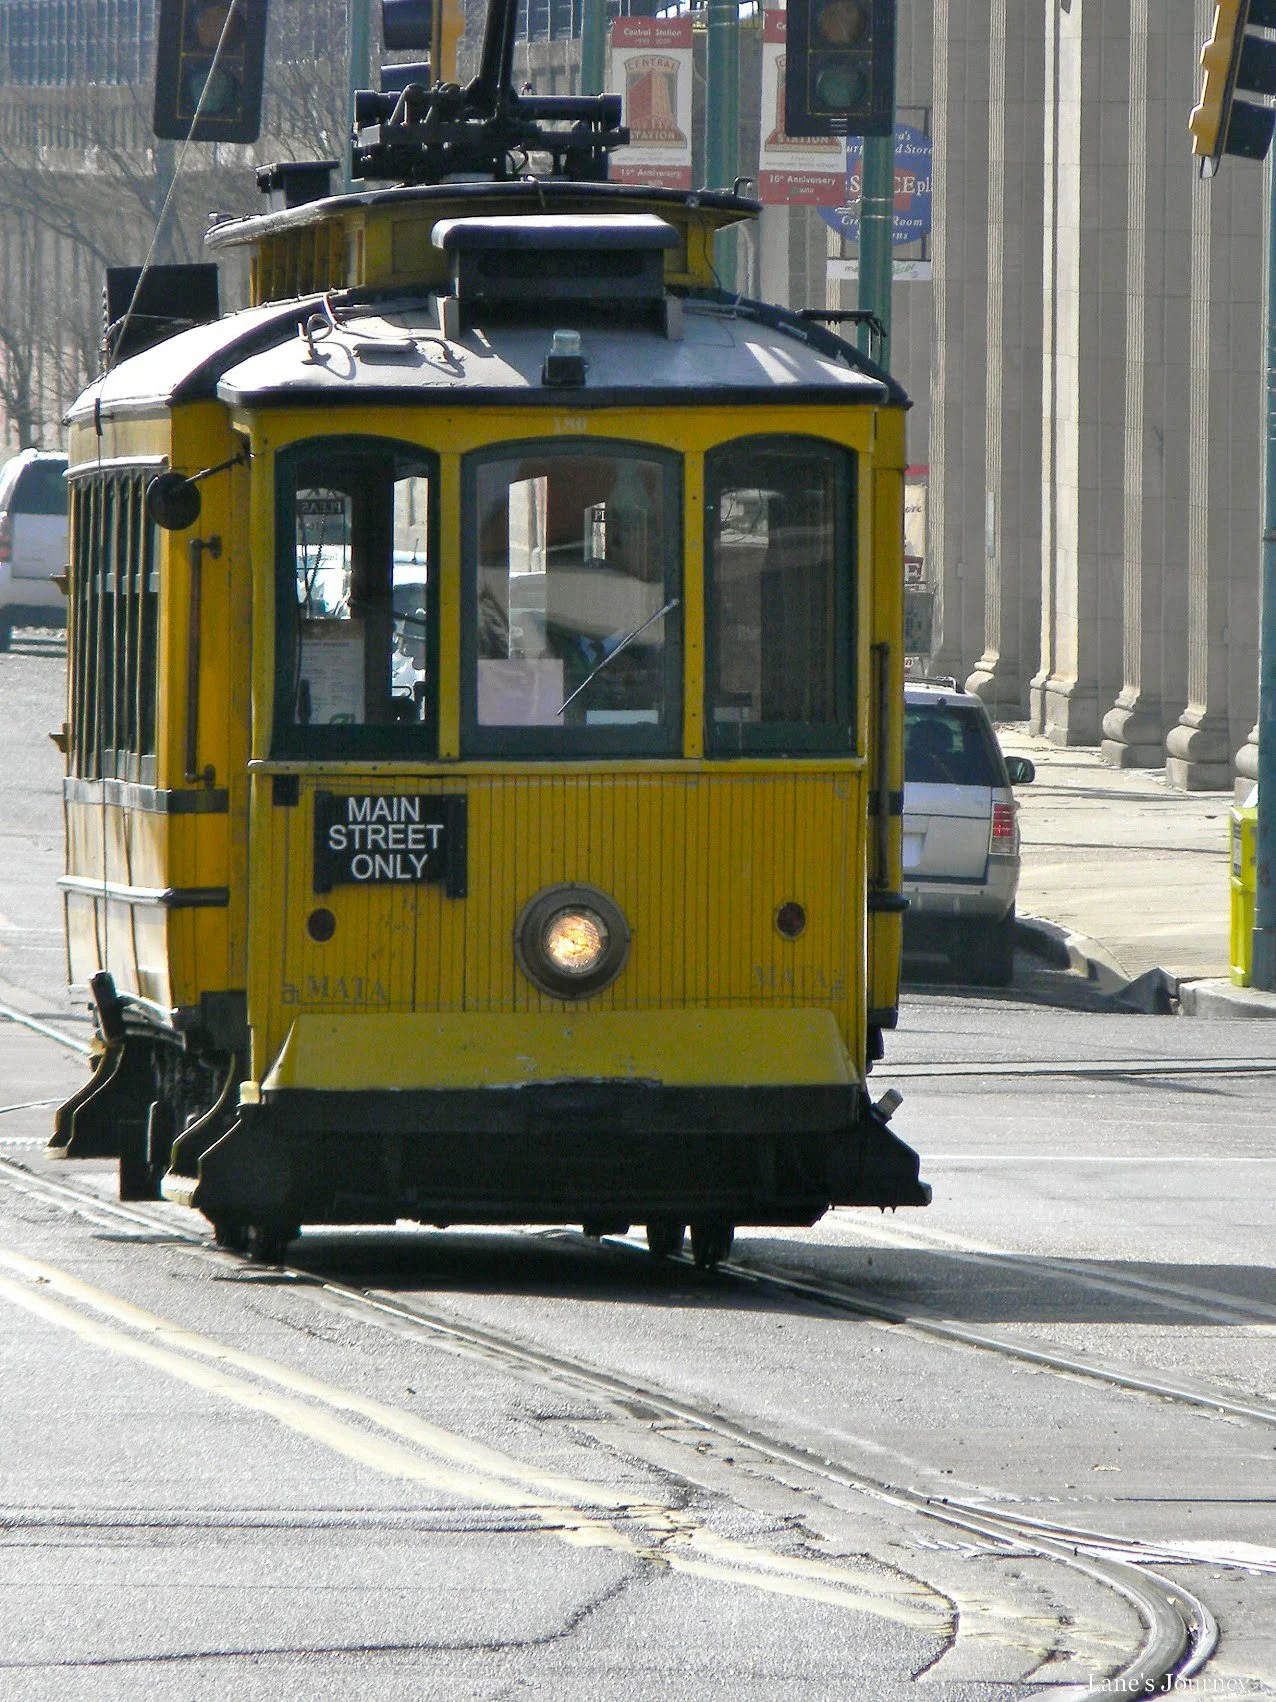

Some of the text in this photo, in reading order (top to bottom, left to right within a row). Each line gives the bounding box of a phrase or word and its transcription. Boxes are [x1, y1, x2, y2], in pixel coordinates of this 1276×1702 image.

[623, 28, 682, 36] Central Station
[627, 58, 675, 70] CENTRAL
[630, 130, 675, 139] STATION
[787, 175, 836, 187] Anniversary
[893, 215, 923, 227] Room
[348, 797, 420, 822] MAIN
[328, 824, 444, 850] STREET
[350, 853, 429, 880] ONLY
